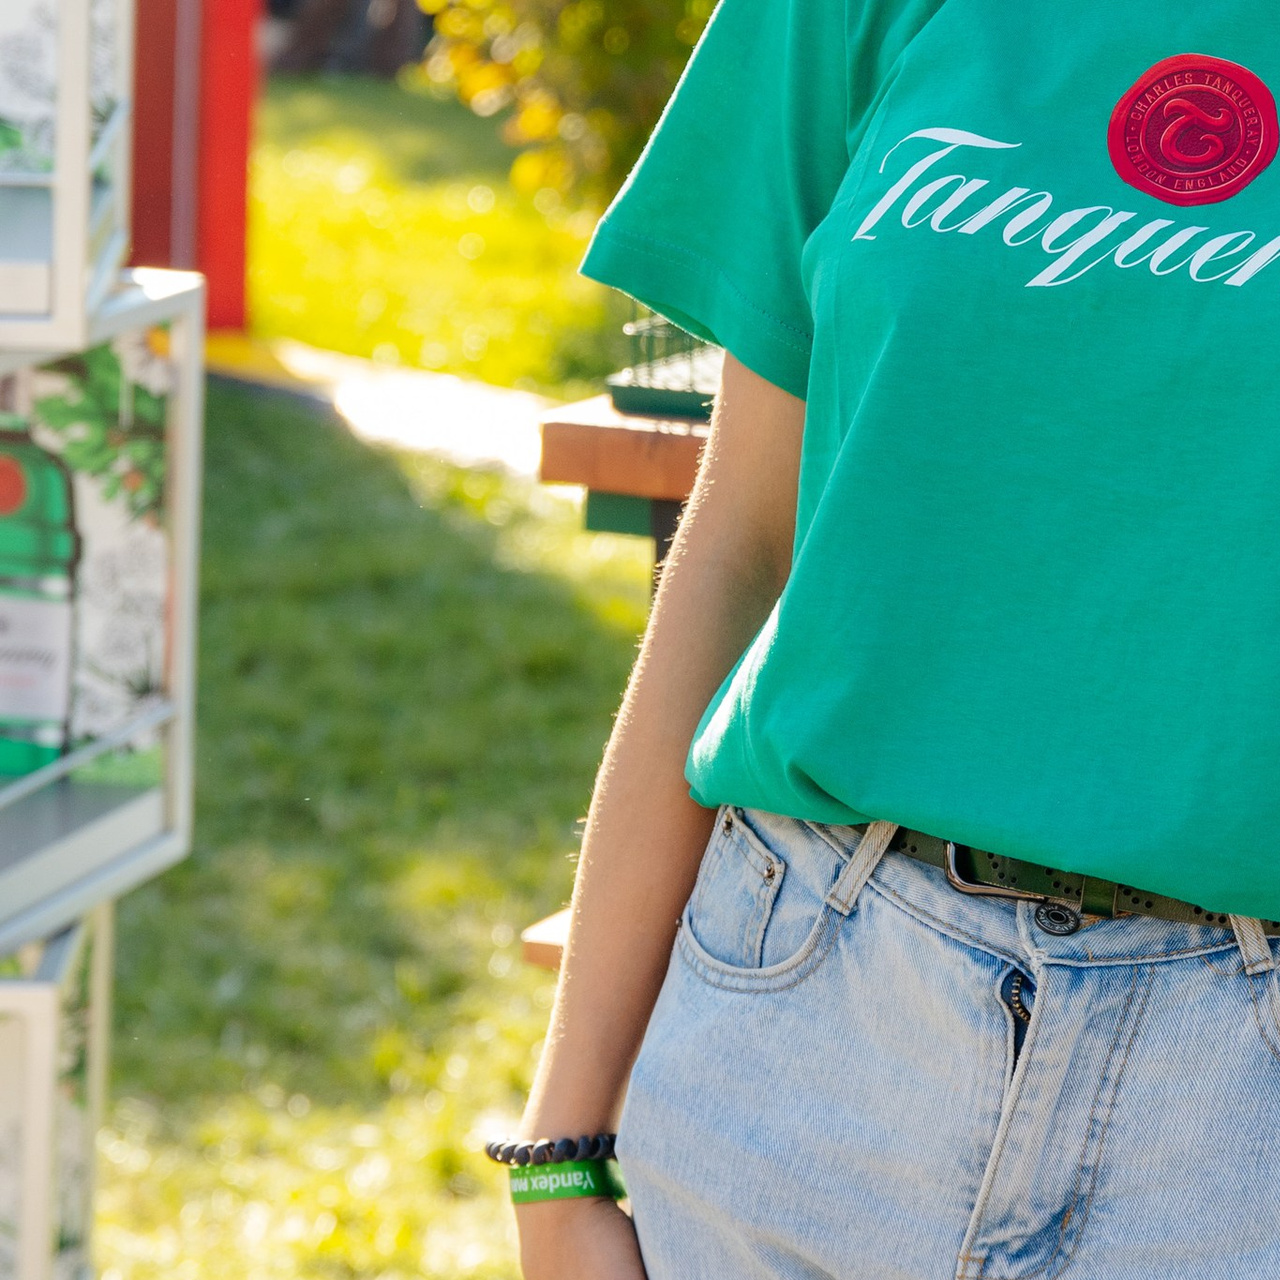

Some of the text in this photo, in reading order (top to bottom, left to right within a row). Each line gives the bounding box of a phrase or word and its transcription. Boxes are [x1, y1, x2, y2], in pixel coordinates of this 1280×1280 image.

[1130, 72, 1260, 147] CHARLES TANQUERAY
[1125, 135, 1248, 191] LONDON ENGLAND
[530, 1170, 595, 1194] Yandex
